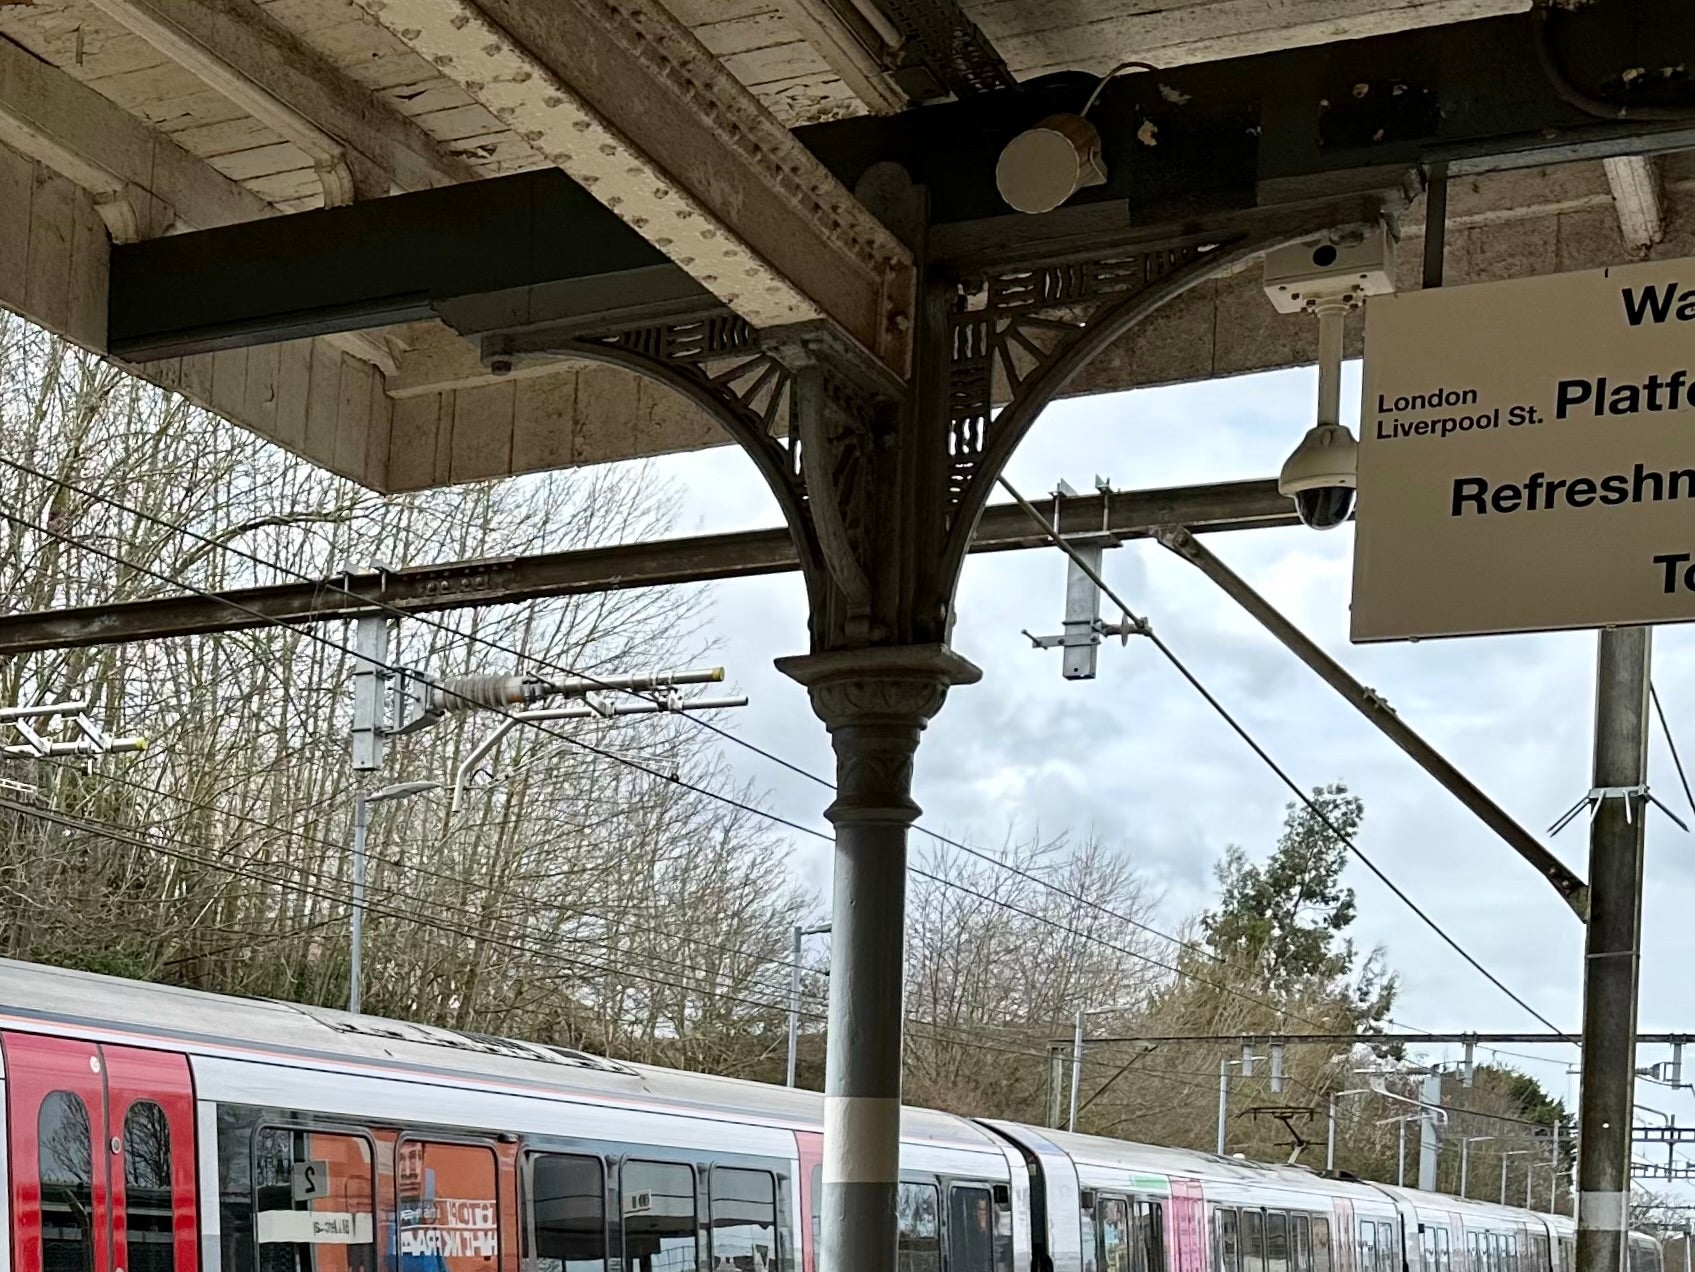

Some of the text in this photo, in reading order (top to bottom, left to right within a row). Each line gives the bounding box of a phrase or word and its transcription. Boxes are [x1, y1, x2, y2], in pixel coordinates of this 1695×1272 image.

[1377, 387, 1478, 414] London
[1376, 405, 1544, 440] Liverpool St.
